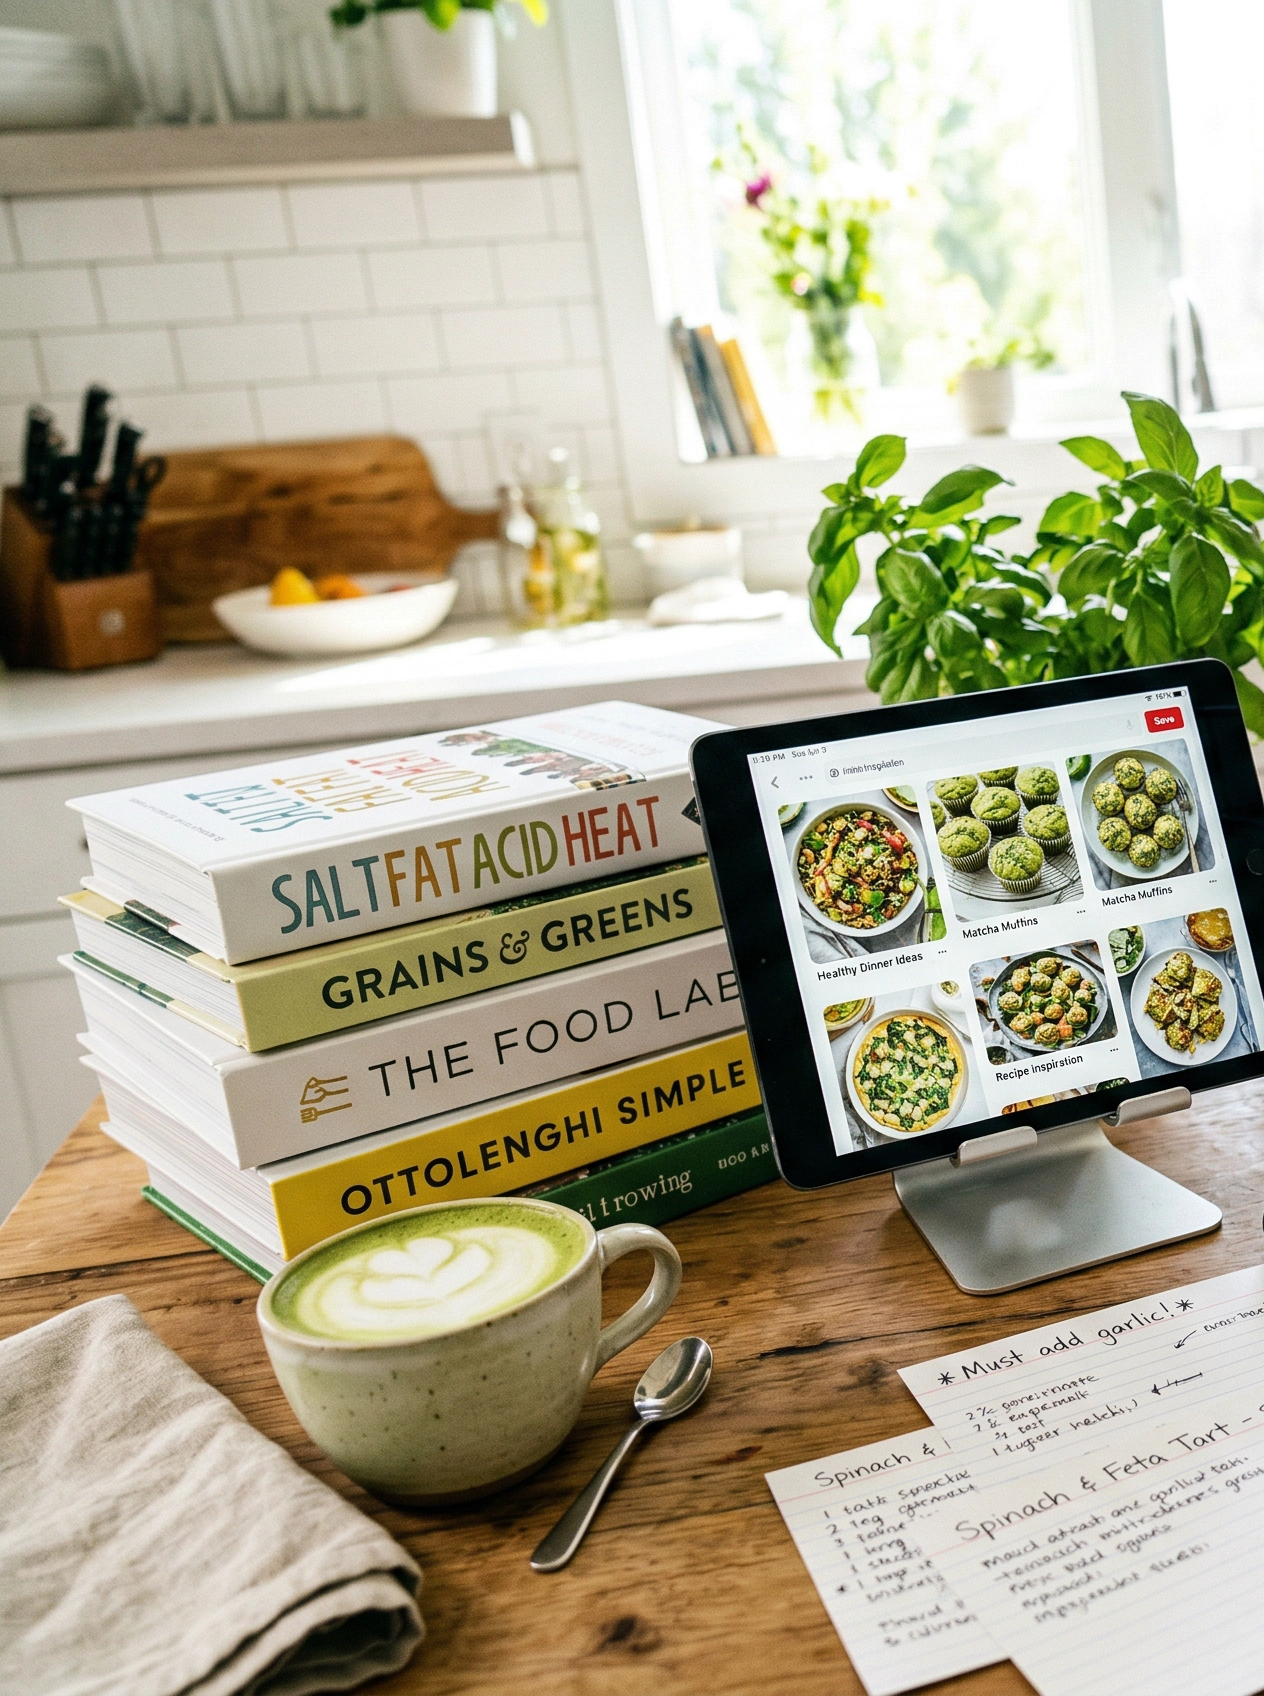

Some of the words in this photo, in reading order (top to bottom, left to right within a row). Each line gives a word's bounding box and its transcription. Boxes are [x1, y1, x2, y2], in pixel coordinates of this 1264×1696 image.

[271, 855, 380, 935] SALT
[383, 838, 462, 908] FAT
[473, 821, 559, 889] ACID
[561, 795, 661, 867] HEAT
[1102, 893, 1137, 907] Matcha
[321, 940, 489, 1010] GRAINS
[499, 930, 530, 965] &
[540, 888, 694, 954] GREENS
[962, 923, 1000, 939] Matcha
[817, 966, 858, 982] Healthy
[860, 958, 894, 972] Dinner
[895, 951, 924, 964] Ideas
[368, 1041, 474, 1097] THE
[494, 1000, 634, 1065] FOOD
[655, 970, 740, 1021] LAB
[995, 1065, 1030, 1082] Recipe
[341, 1106, 603, 1217] OTTOLENGHI
[619, 1059, 747, 1126] SIMPLE
[1039, 1331, 1084, 1356] add
[814, 1453, 912, 1488] Spinach
[922, 1442, 936, 1457] &
[955, 1489, 1071, 1542] Spinach
[1080, 1475, 1097, 1493] &
[1103, 1453, 1169, 1481] Feta
[1168, 1422, 1231, 1452] Tart
